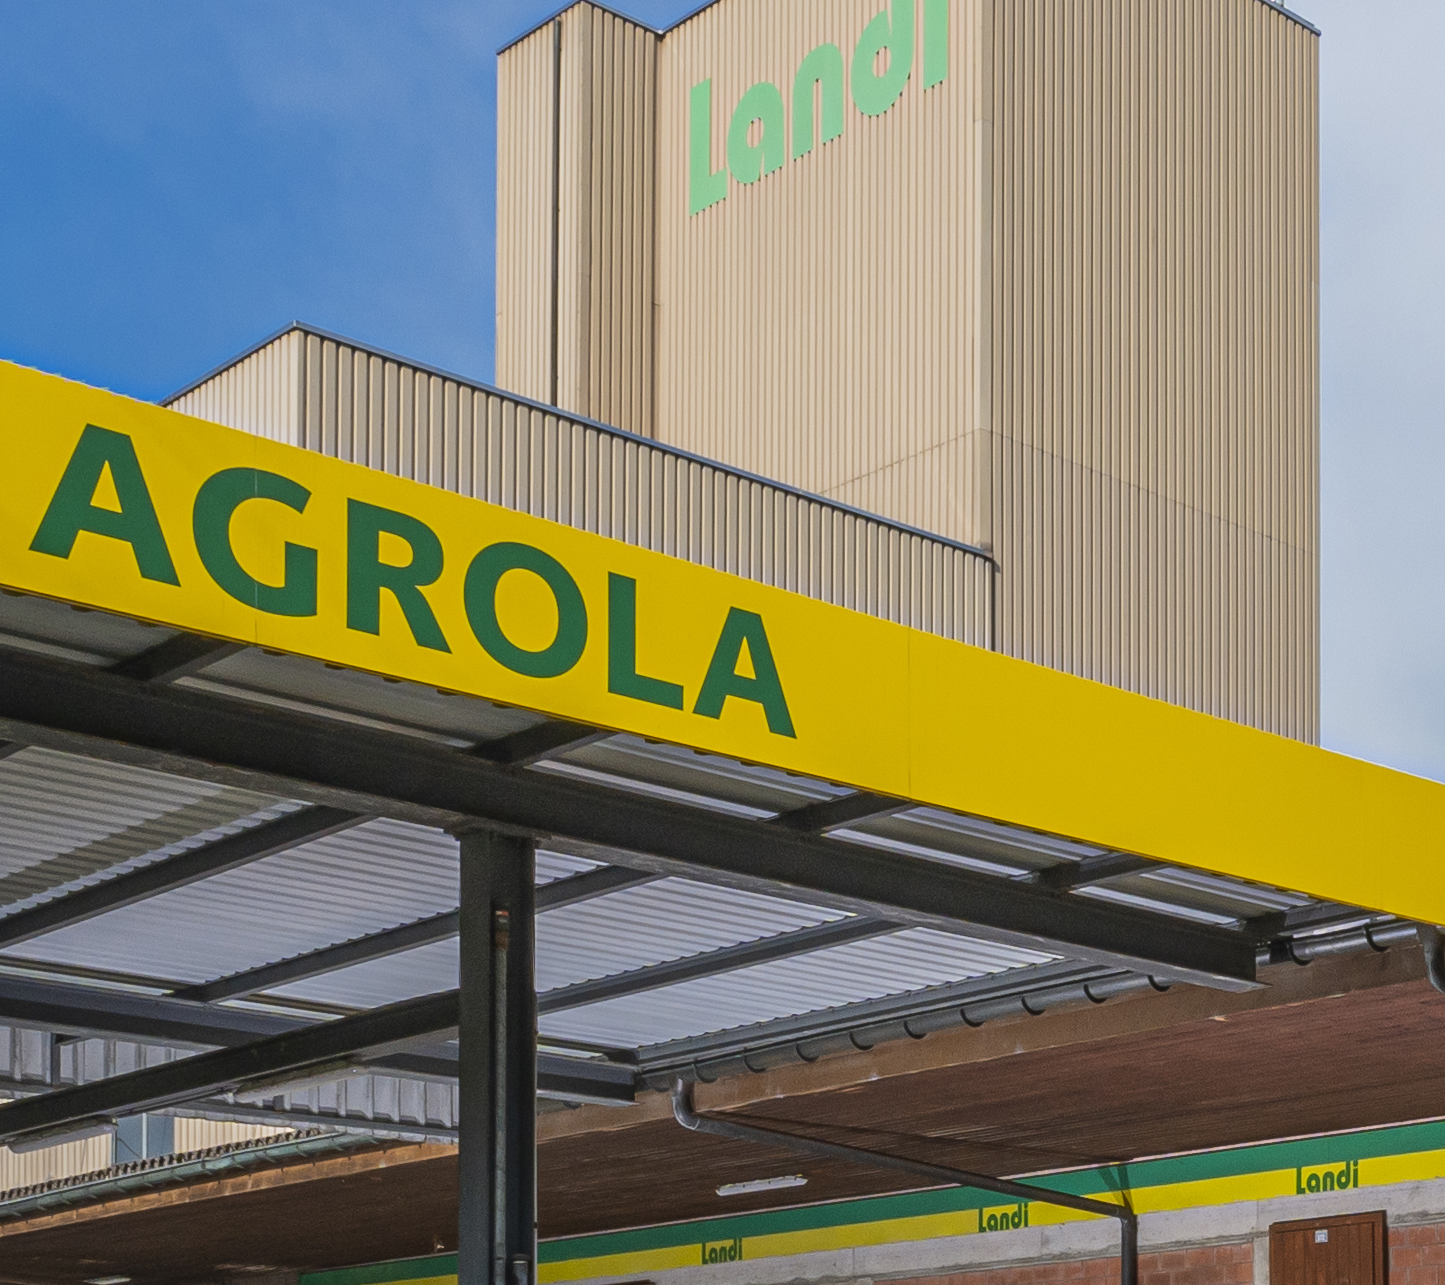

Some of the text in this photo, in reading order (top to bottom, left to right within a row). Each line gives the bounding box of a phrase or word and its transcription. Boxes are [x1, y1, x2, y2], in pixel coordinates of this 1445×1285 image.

[28, 423, 798, 739] AGROLA
[1297, 1161, 1359, 1195] Landi
[978, 1202, 1029, 1233] Landi
[701, 1237, 743, 1265] Landi
